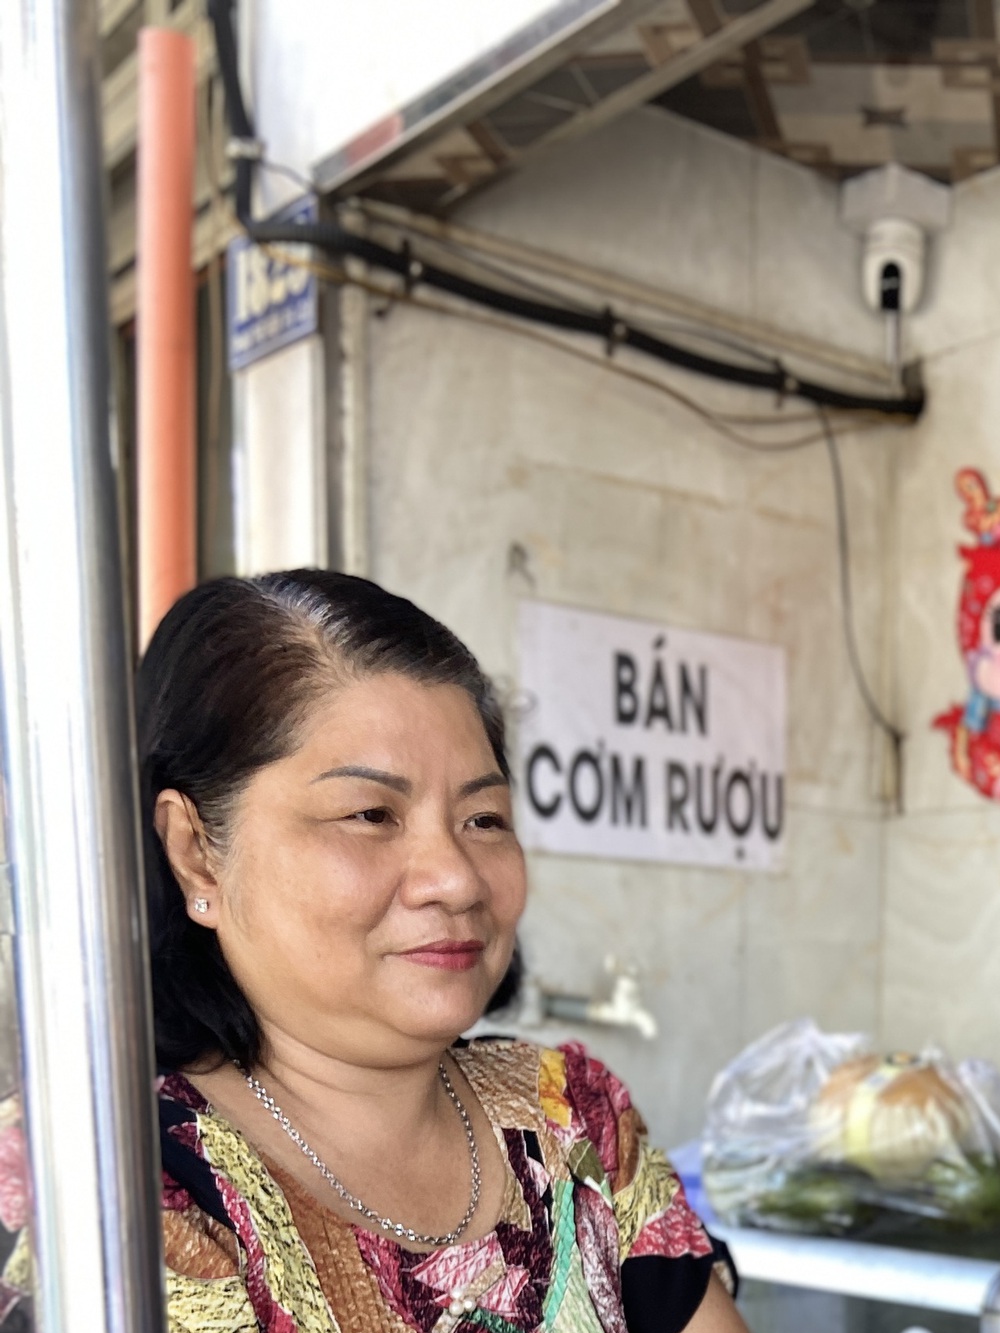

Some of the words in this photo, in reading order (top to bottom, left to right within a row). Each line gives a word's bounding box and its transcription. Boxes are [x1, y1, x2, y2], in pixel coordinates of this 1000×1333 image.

[614, 632, 709, 738] BÁN
[525, 737, 648, 831] CƠM
[665, 752, 785, 861] RƯỢU
